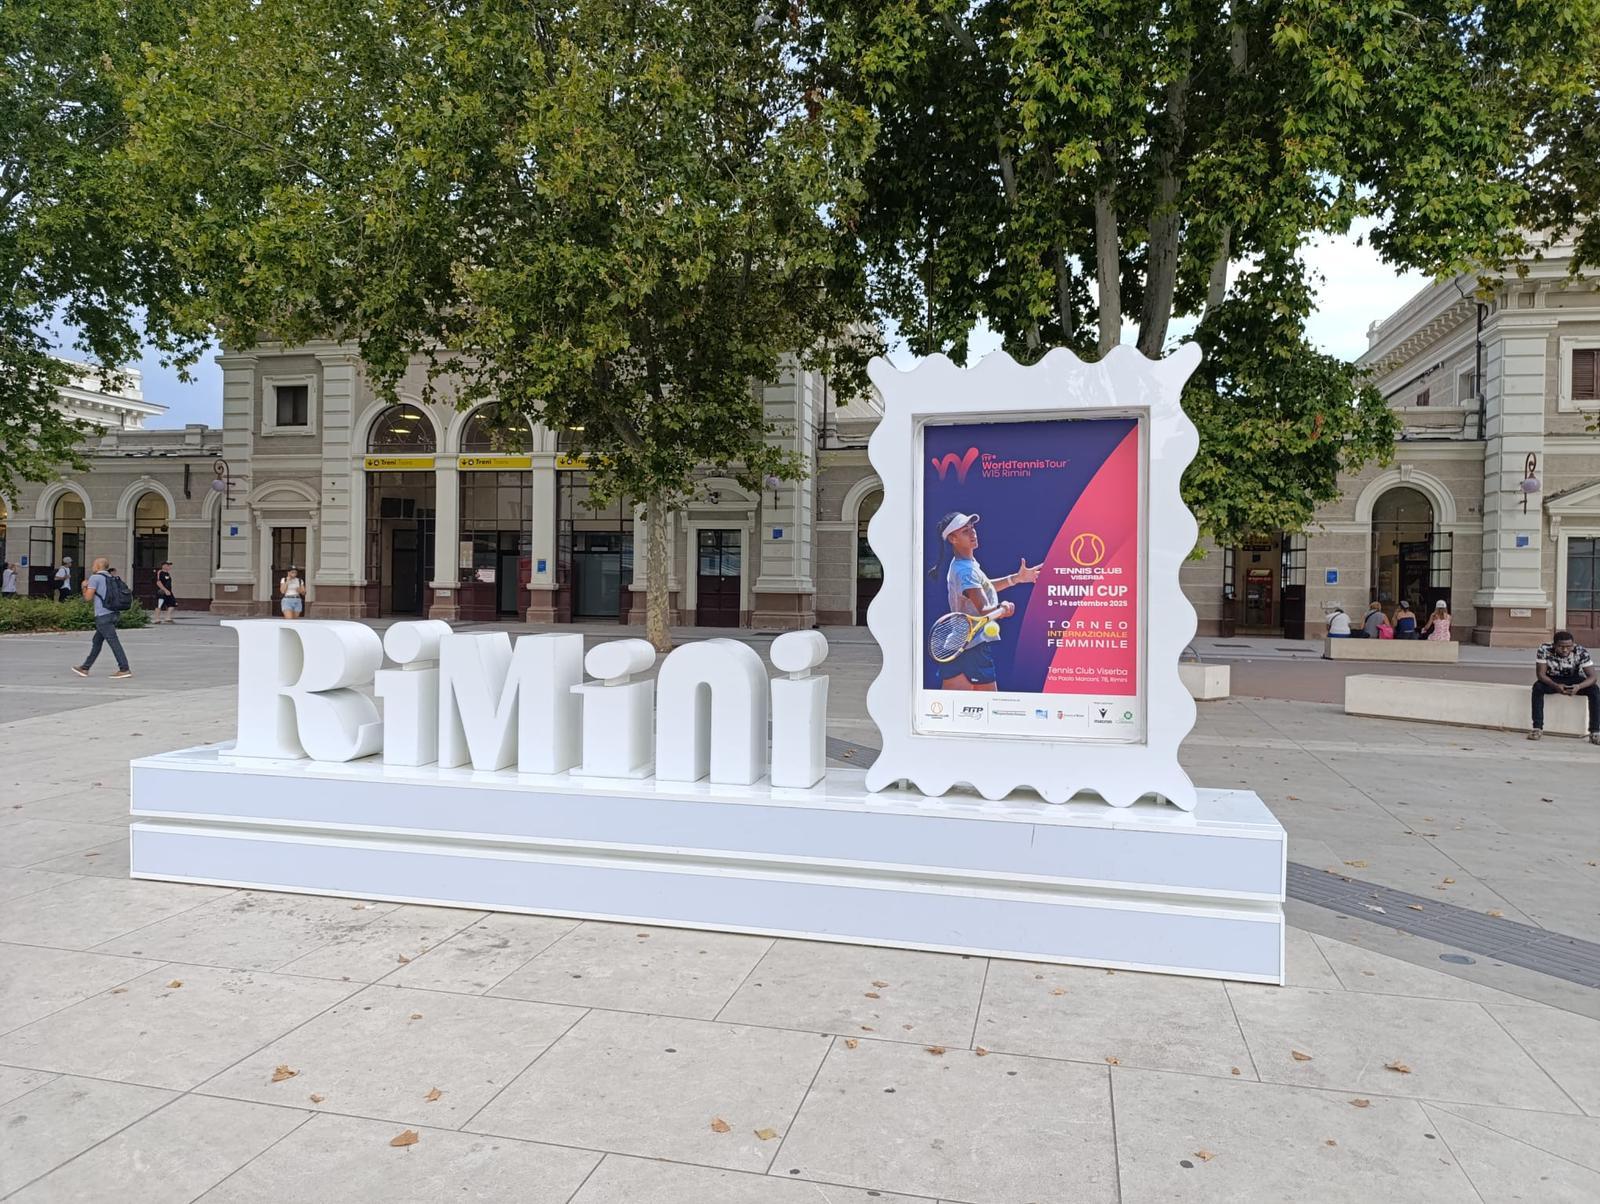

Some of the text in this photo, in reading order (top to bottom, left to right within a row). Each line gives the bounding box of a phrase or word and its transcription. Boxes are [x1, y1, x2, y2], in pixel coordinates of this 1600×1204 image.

[381, 457, 397, 465] Treni
[982, 459, 1066, 469] WorldTennisTour
[982, 469, 1031, 477] W15 Rimini
[1053, 567, 1122, 575] TENNIS CLUB
[1047, 585, 1128, 597] RIMINI CUP
[1047, 620, 1128, 630] TORNEO
[1047, 630, 1128, 638] INTERNAZIONALE
[1047, 639, 1128, 649] FEMMINILE
[1048, 666, 1128, 676] Tennis Club Viserba
